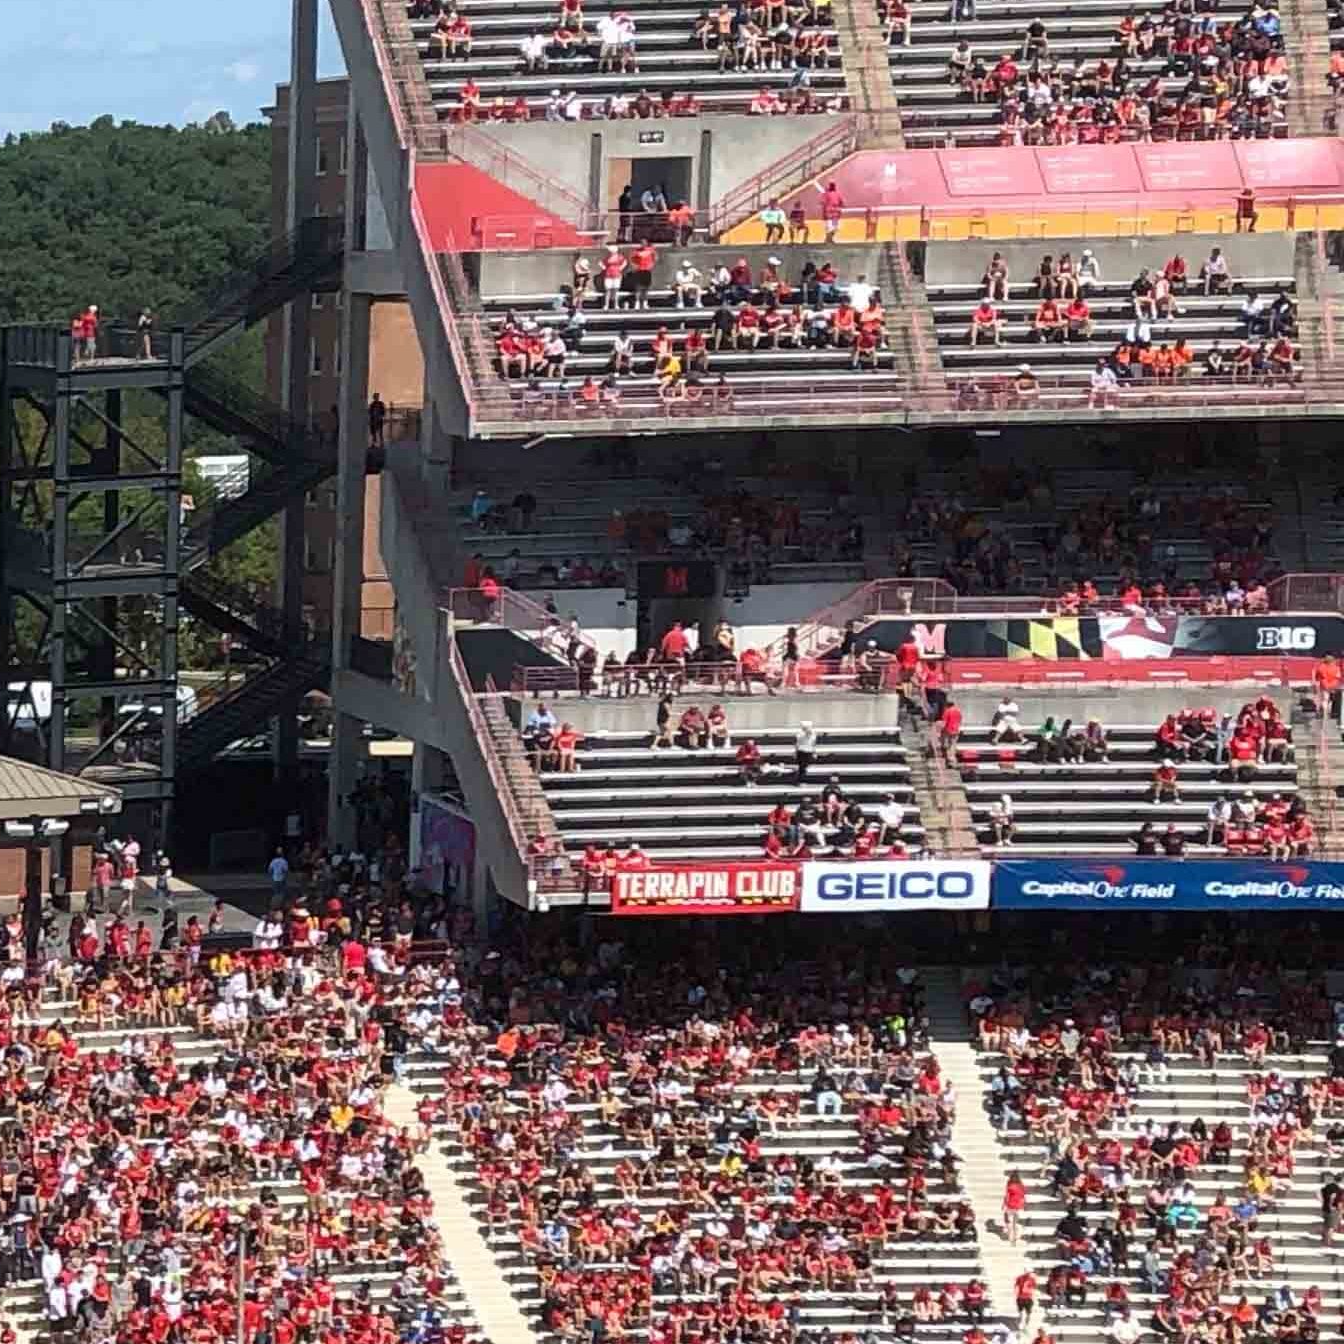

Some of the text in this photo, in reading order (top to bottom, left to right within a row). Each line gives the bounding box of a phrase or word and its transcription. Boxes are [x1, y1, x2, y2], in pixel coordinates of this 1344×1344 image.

[617, 871, 795, 898] TERRAPIN CLUB
[817, 871, 975, 900] GEICO
[1131, 883, 1175, 898] Field
